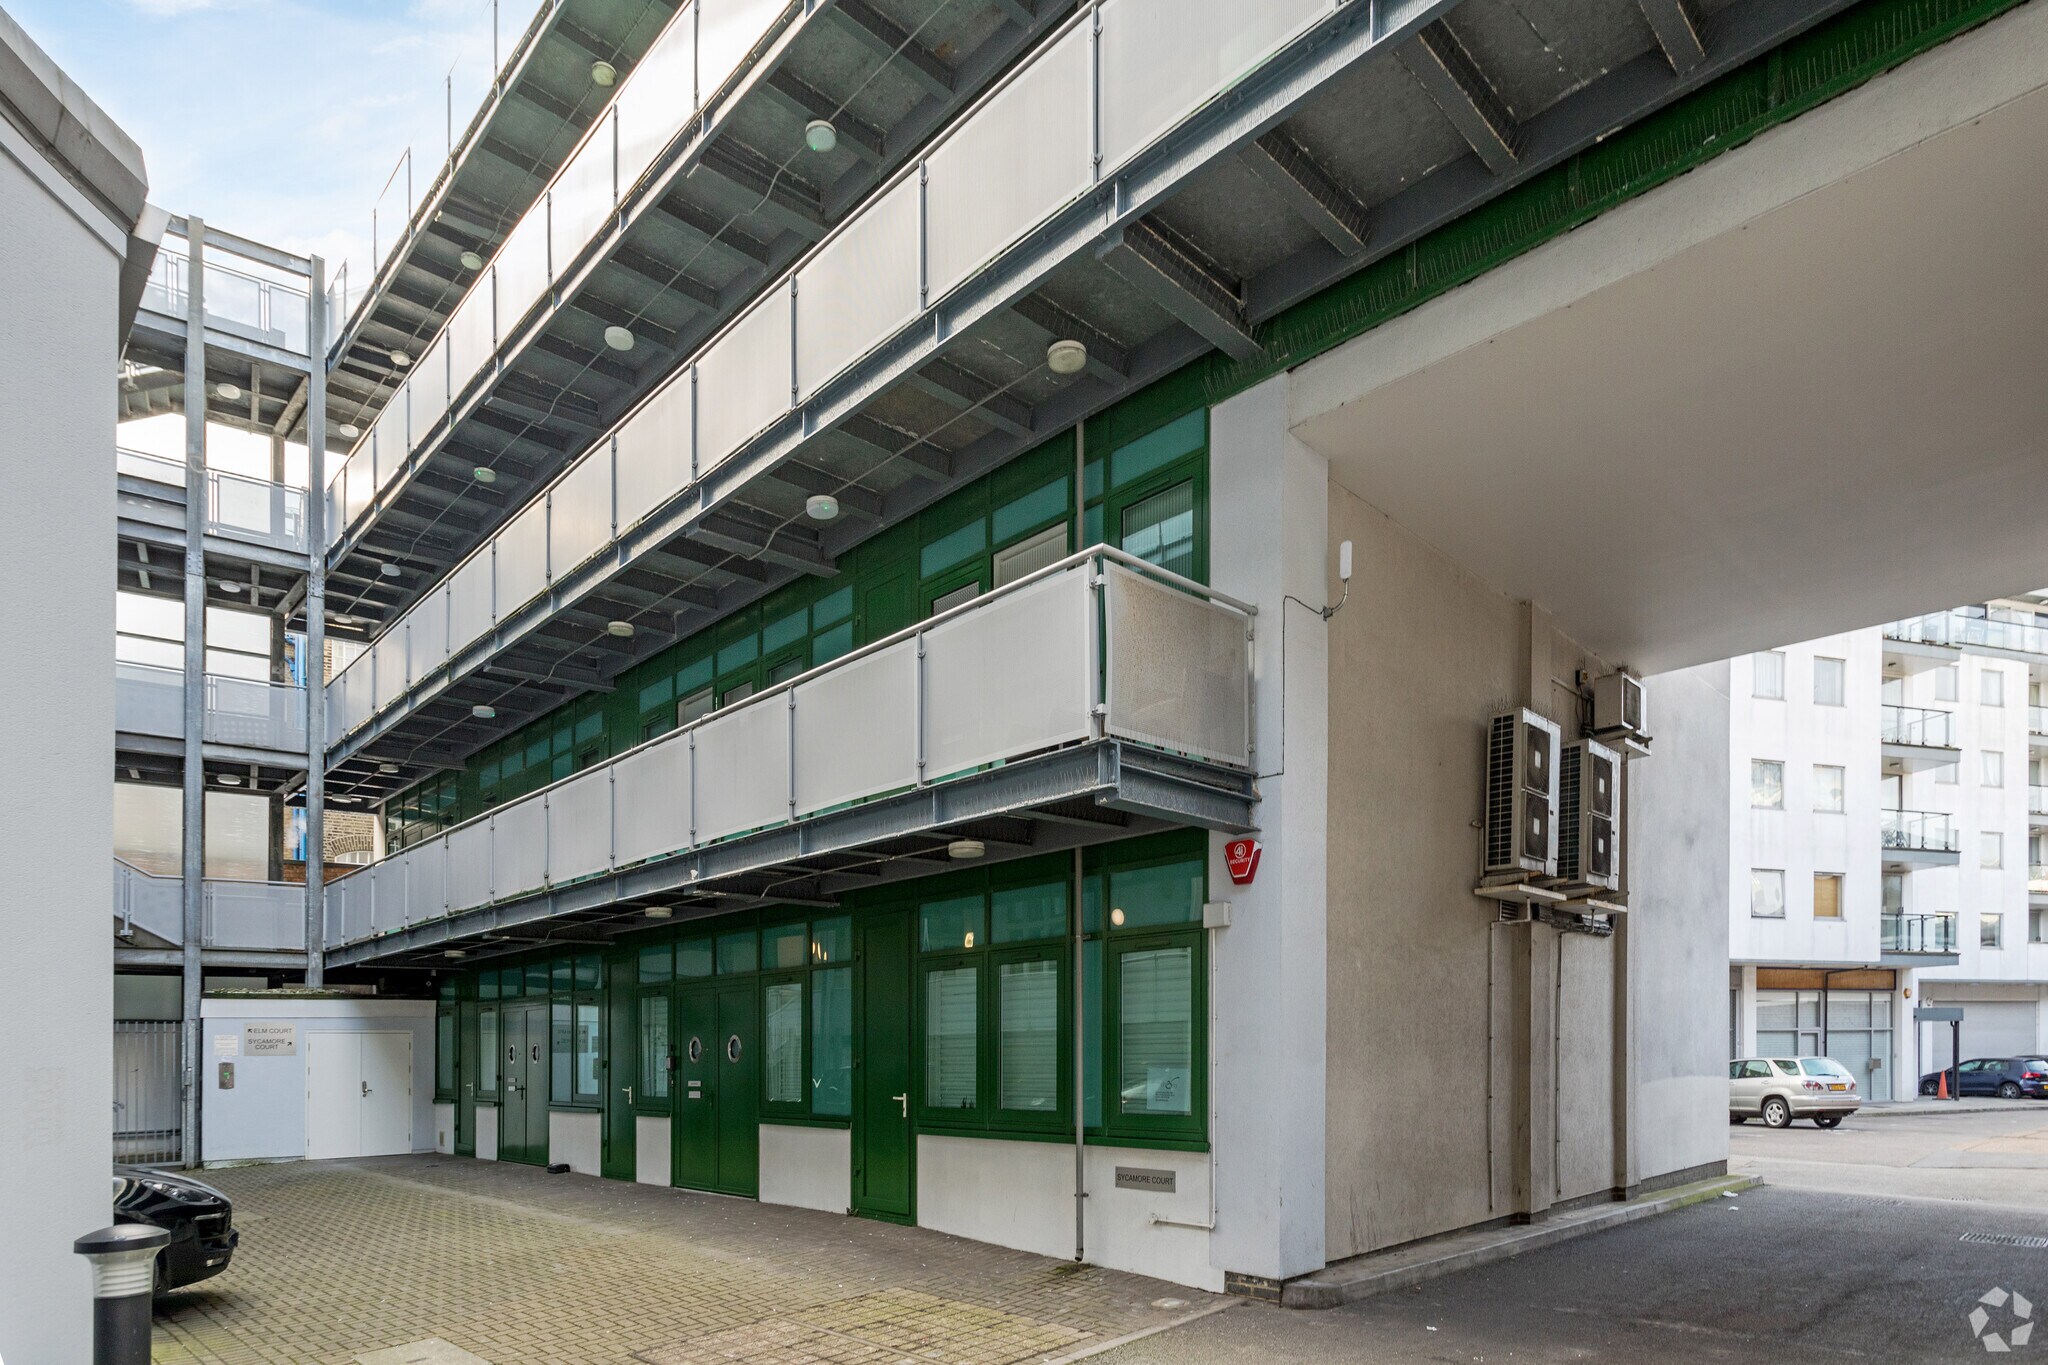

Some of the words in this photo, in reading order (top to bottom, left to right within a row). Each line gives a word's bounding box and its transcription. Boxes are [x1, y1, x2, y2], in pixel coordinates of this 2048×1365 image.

[1230, 857, 1250, 865] SECURITY
[1117, 1173, 1151, 1183] SYCAMORE
[1151, 1176, 1174, 1185] COURT
